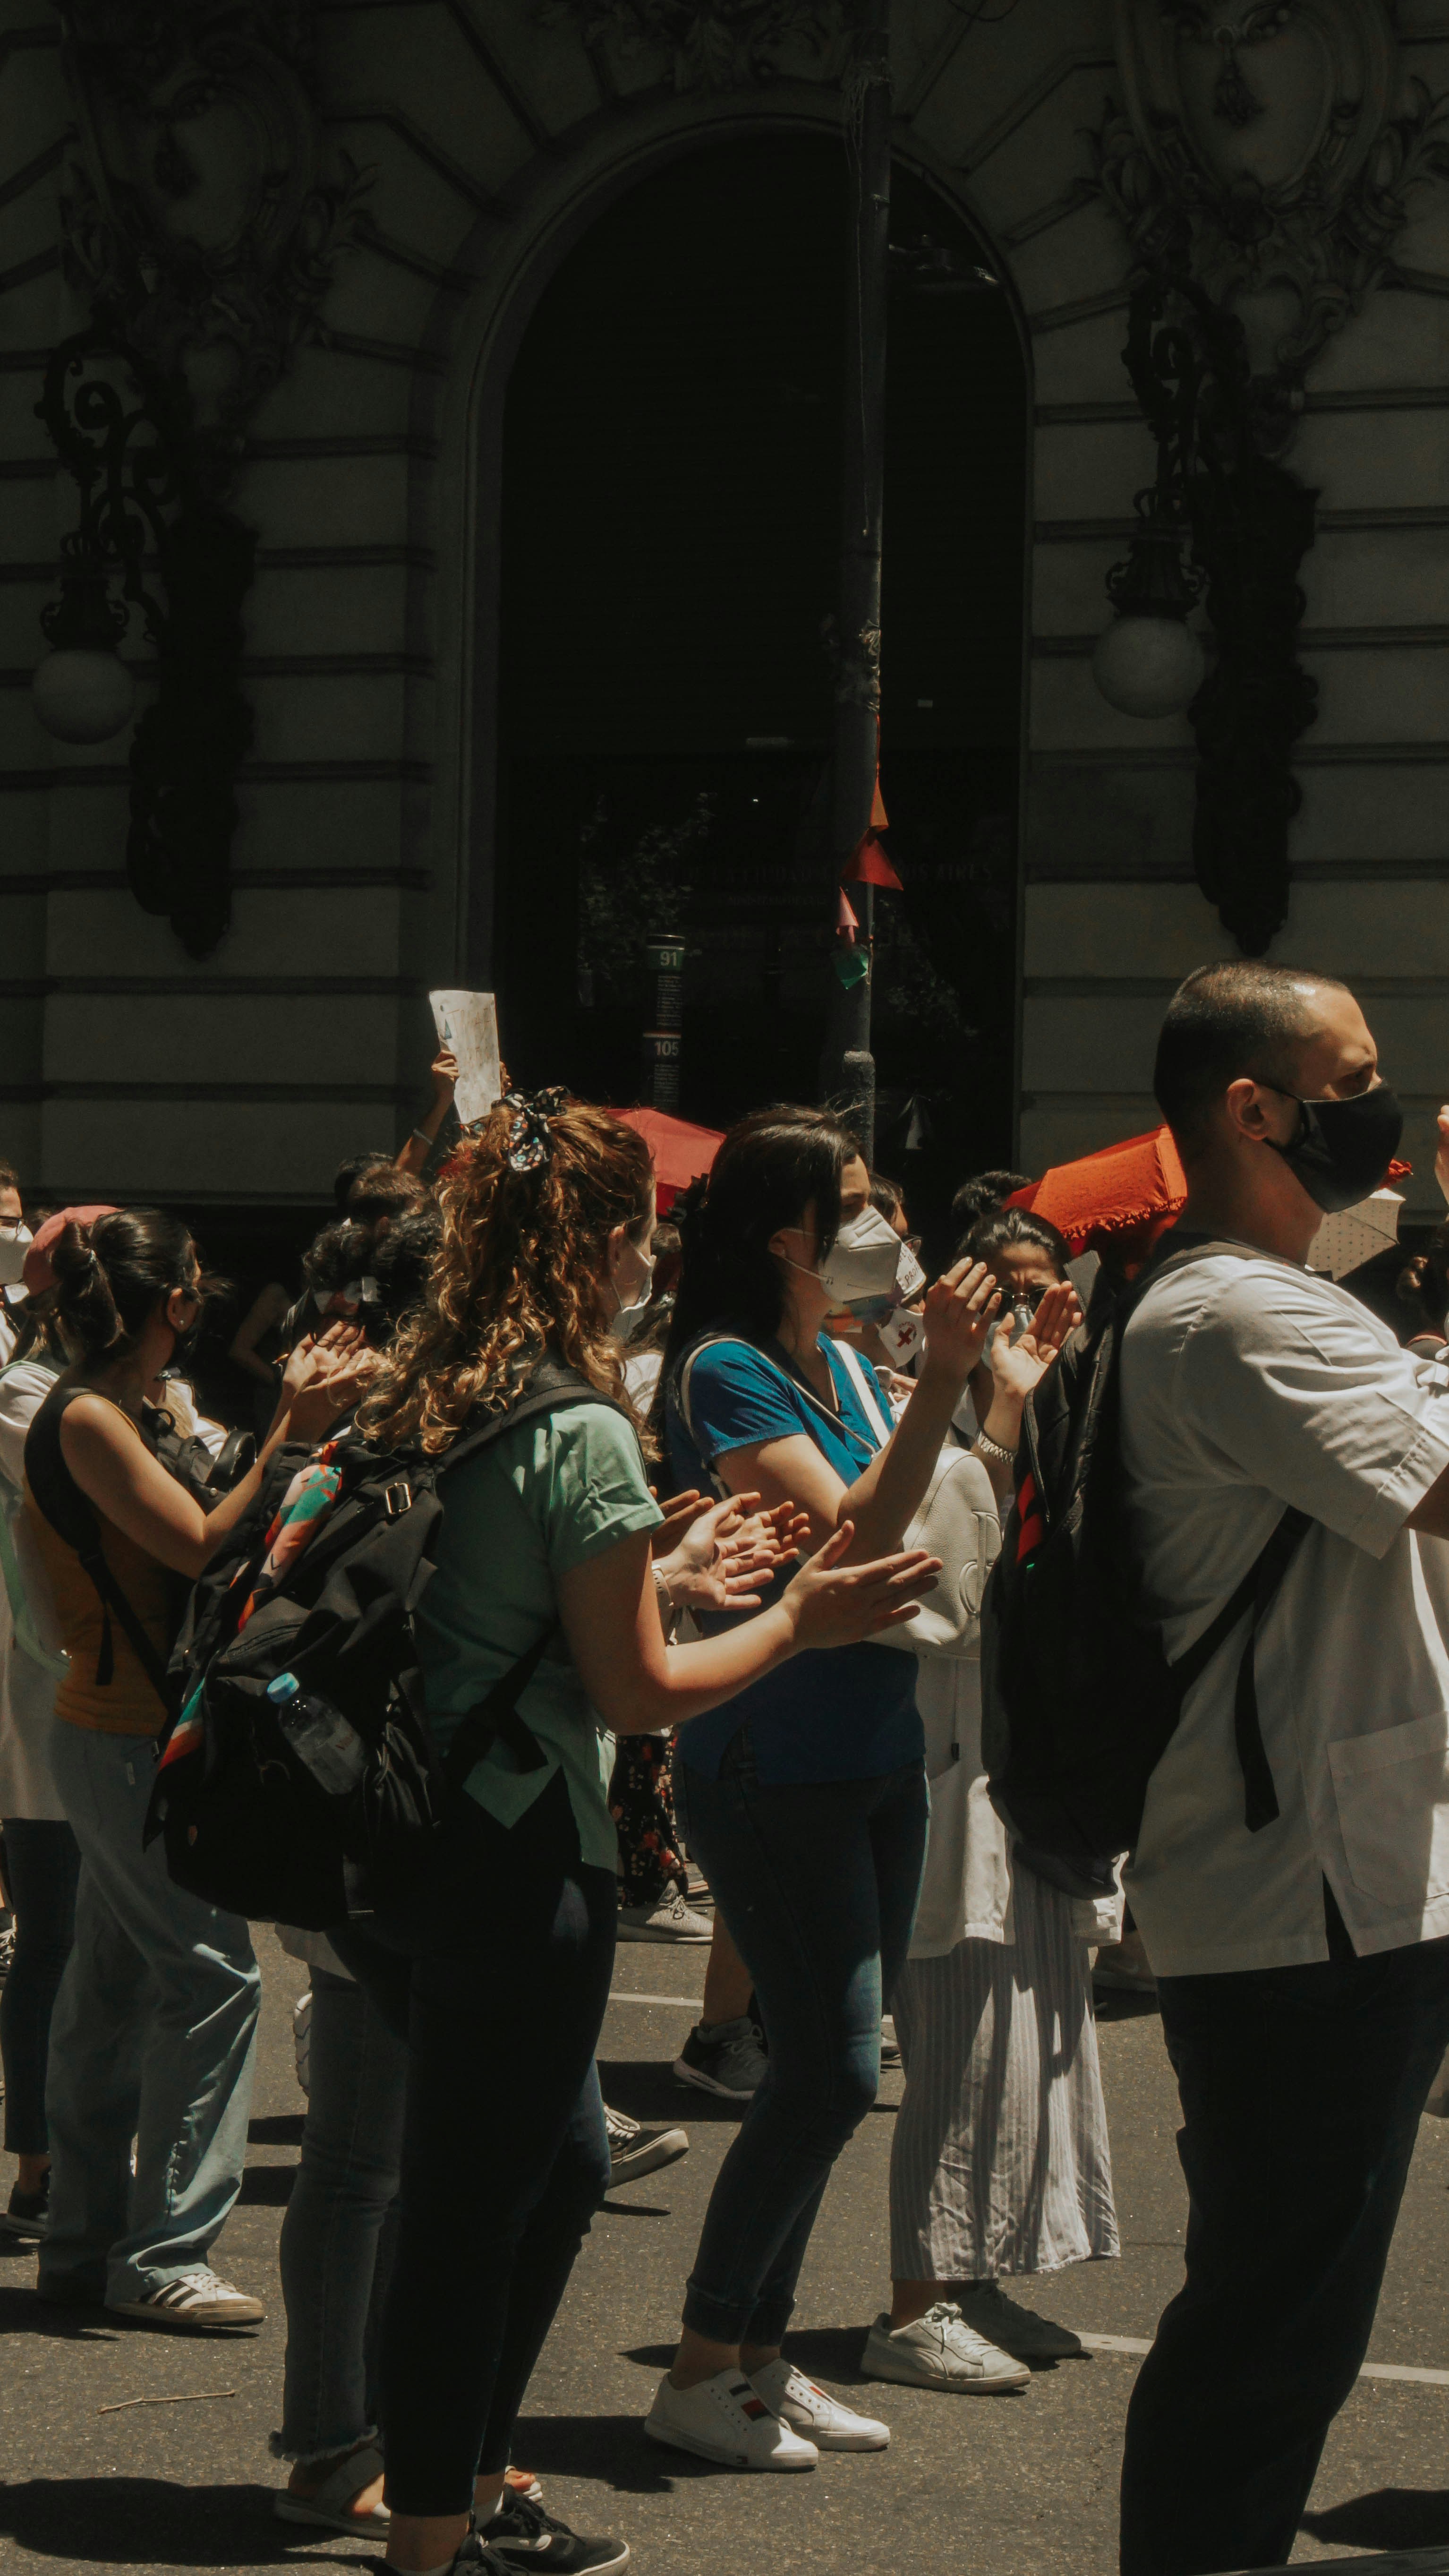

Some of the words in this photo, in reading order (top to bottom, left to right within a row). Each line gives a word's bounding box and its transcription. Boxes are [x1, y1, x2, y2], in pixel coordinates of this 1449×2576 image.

[933, 863, 992, 881] AIRES
[660, 951, 677, 966] 91
[655, 1040, 679, 1056] 105
